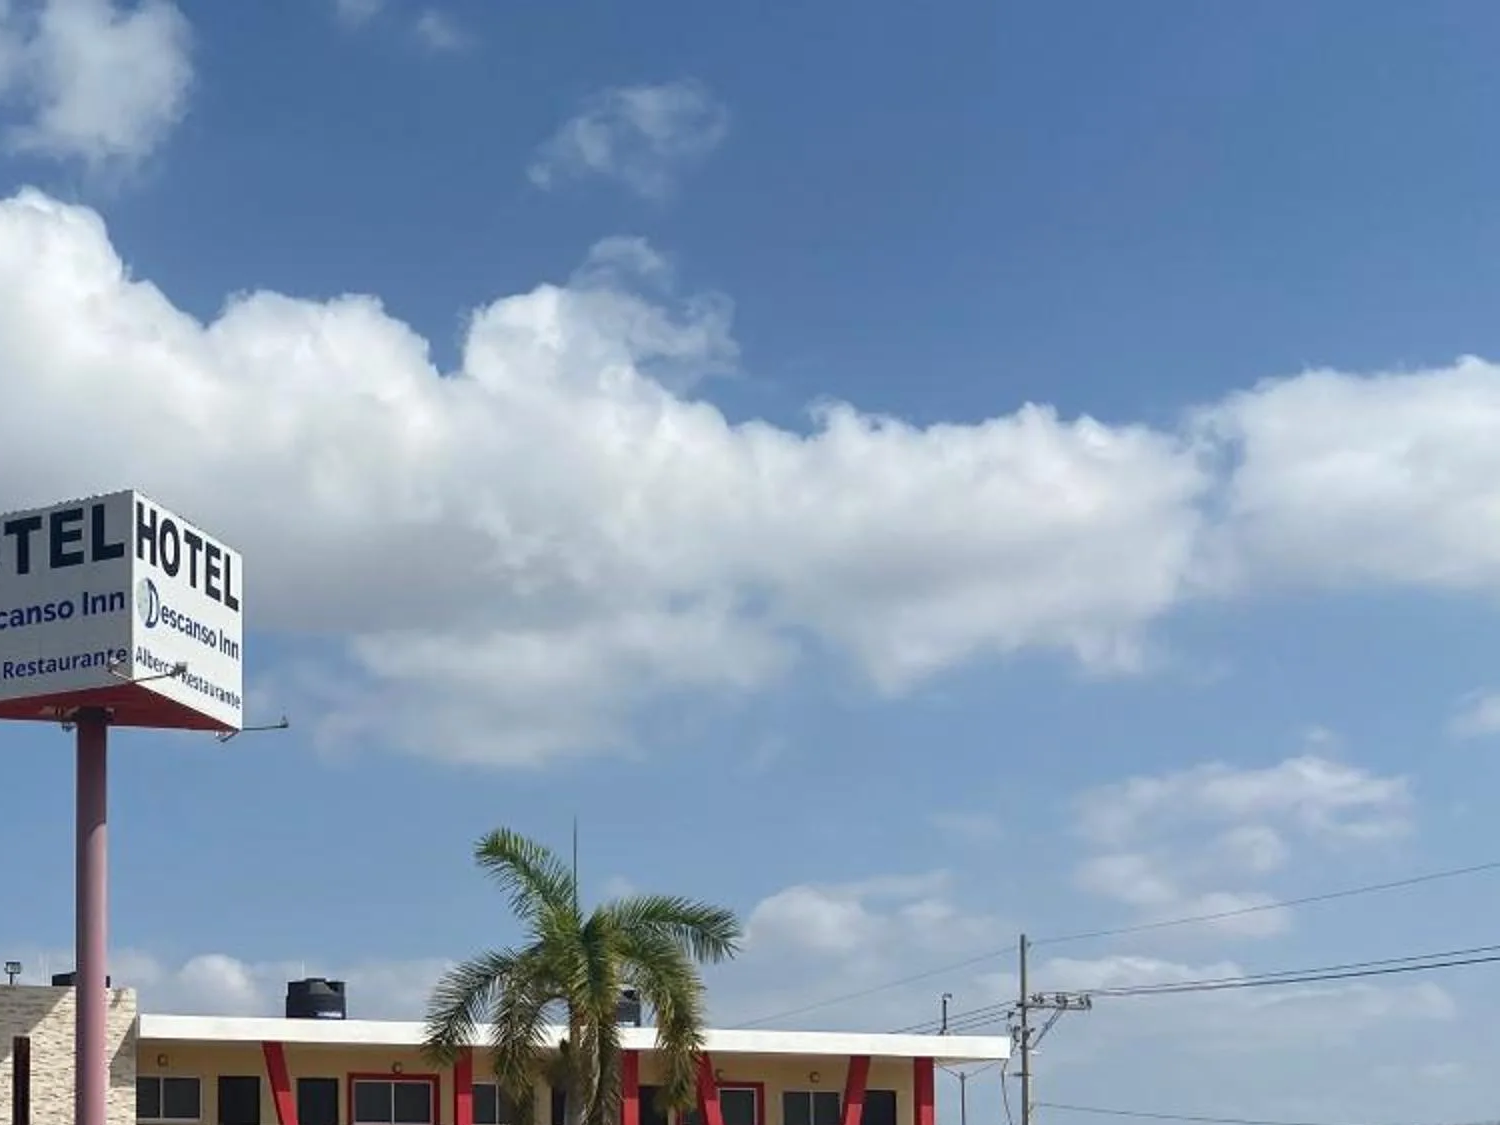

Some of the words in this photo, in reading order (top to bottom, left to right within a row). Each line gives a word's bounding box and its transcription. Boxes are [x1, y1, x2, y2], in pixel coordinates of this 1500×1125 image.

[136, 501, 240, 613] HOTEL
[82, 591, 125, 617] Inn
[145, 577, 217, 648] Descanso
[219, 629, 240, 660] Inn
[3, 648, 128, 680] Restaurante
